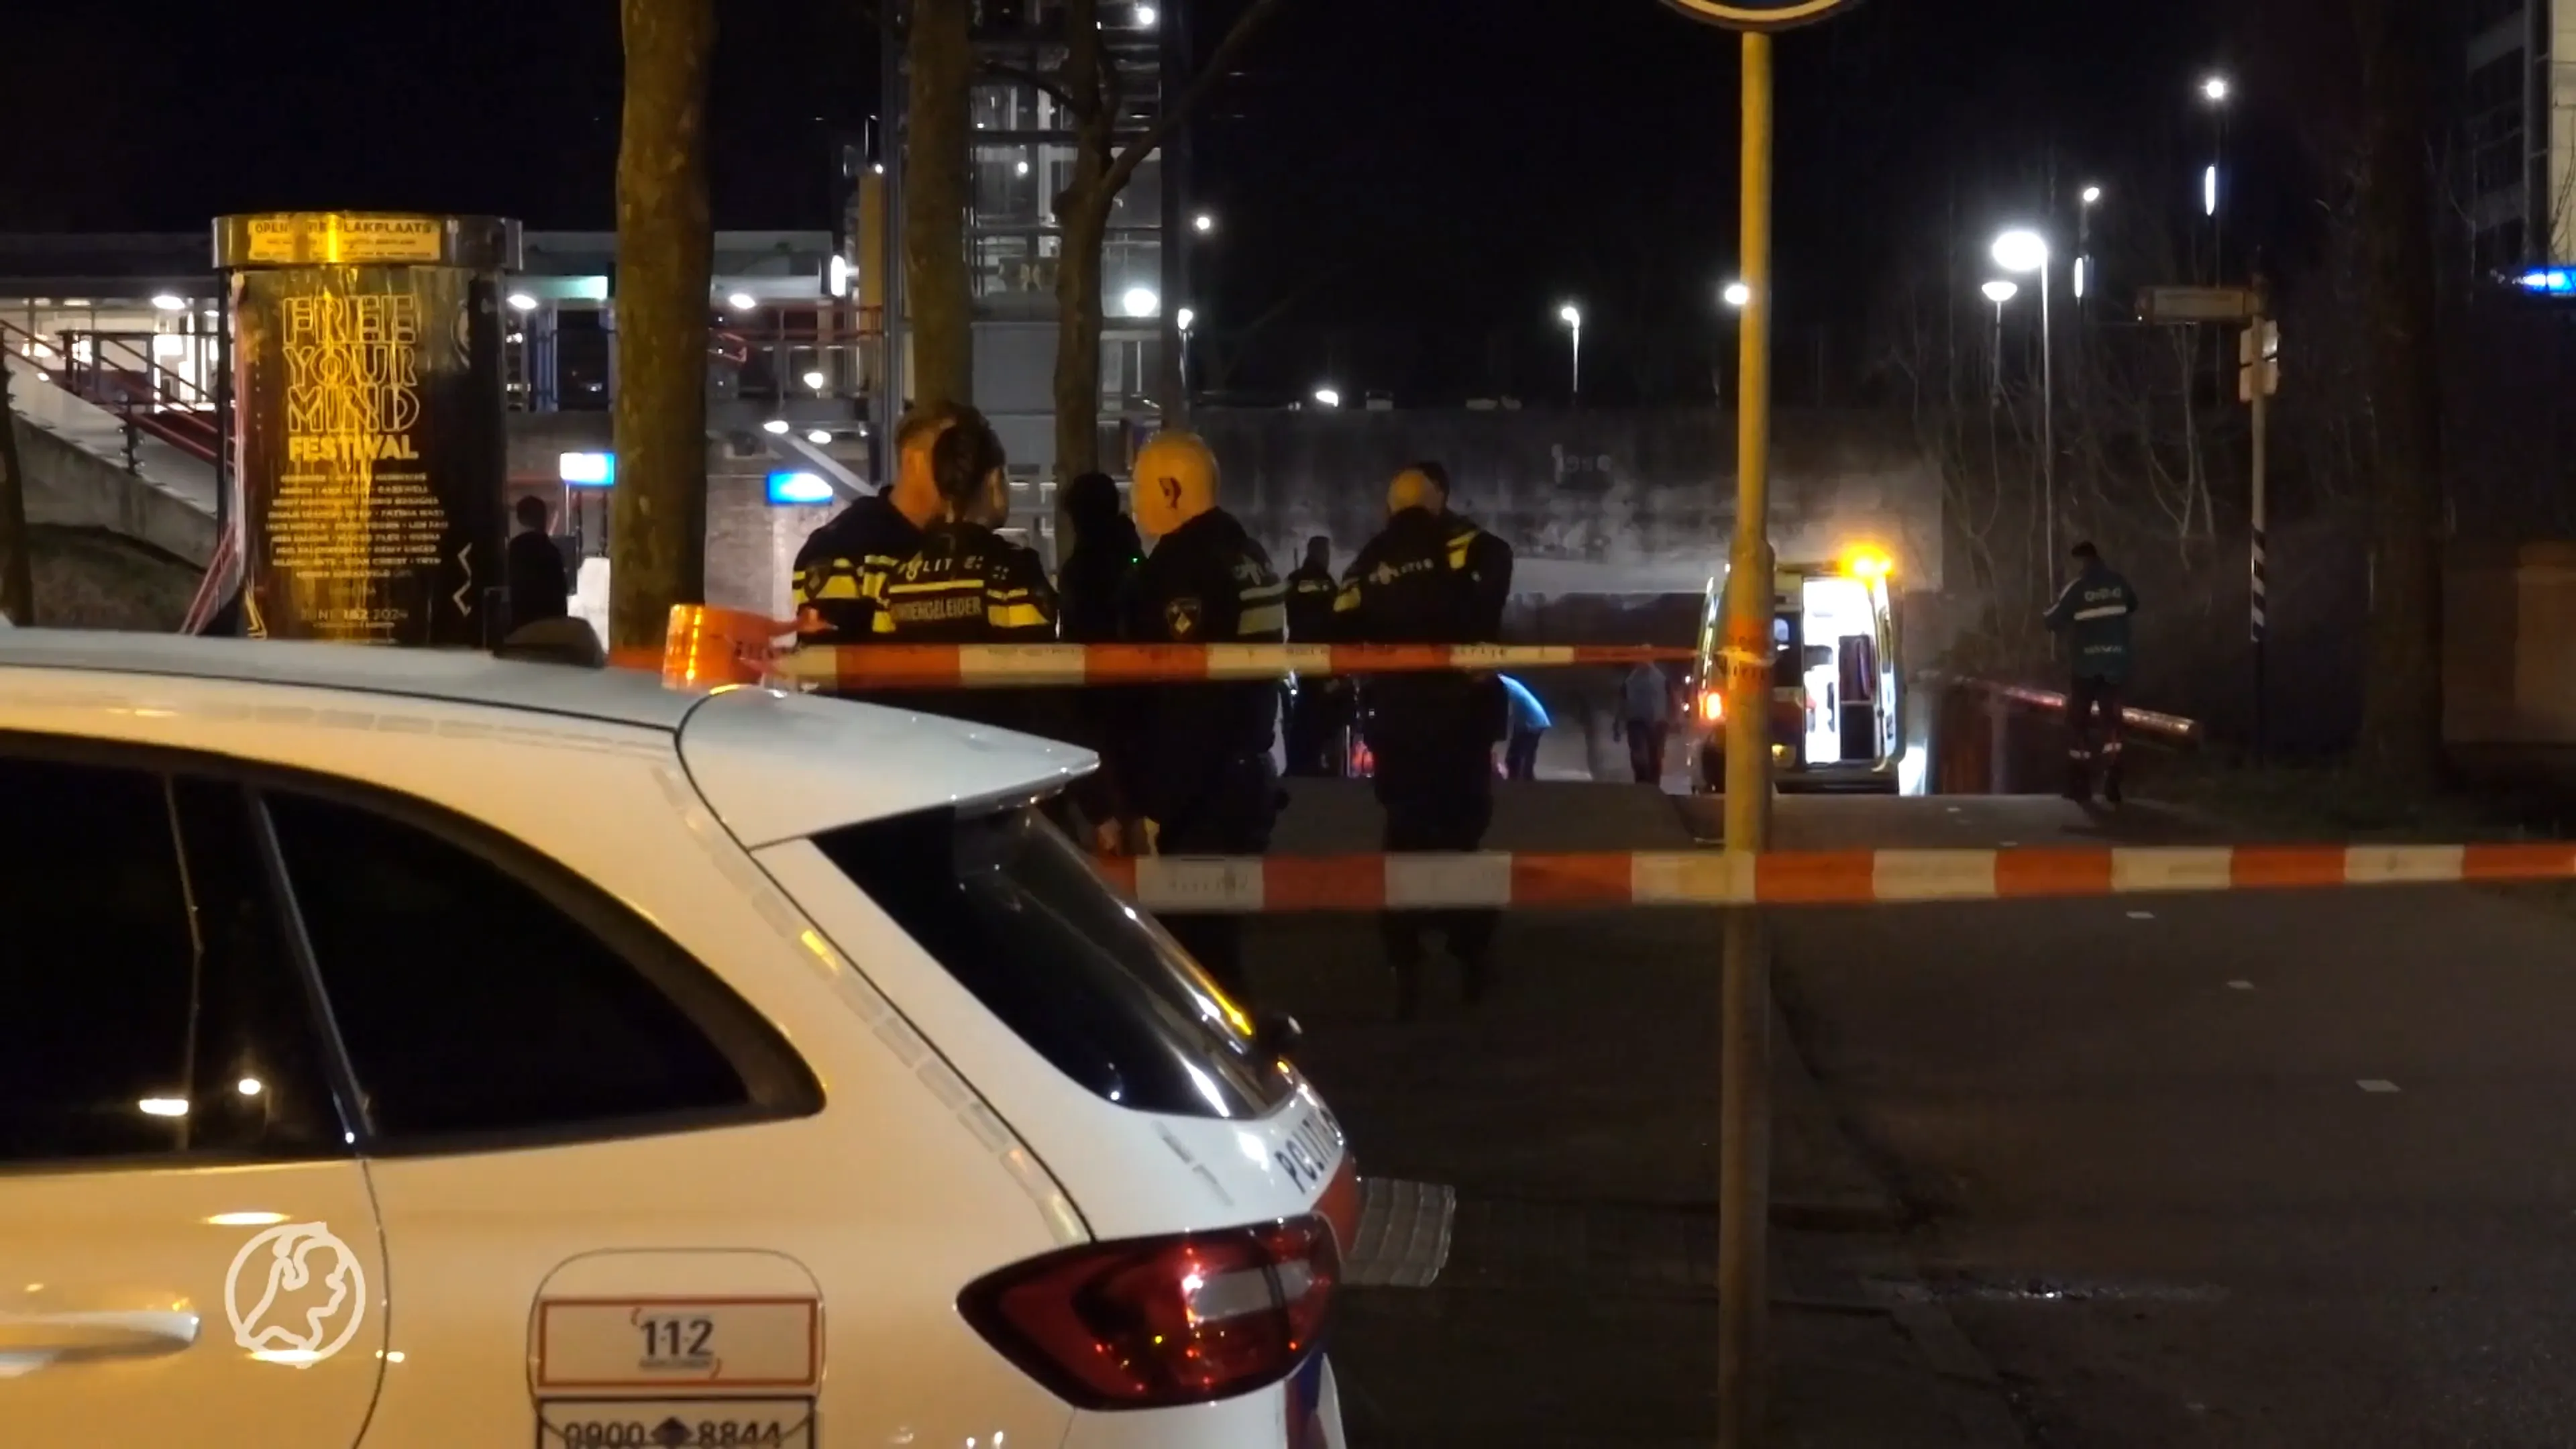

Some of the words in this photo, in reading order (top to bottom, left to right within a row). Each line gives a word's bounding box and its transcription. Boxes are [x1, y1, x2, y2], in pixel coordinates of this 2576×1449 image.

[255, 222, 328, 233] OPENRE
[282, 295, 417, 345] FREE
[282, 345, 418, 387] YOUR
[288, 386, 420, 433] MIND
[289, 435, 419, 460] FESTIVAL
[897, 551, 977, 581] OLITE
[641, 1320, 714, 1356] 112
